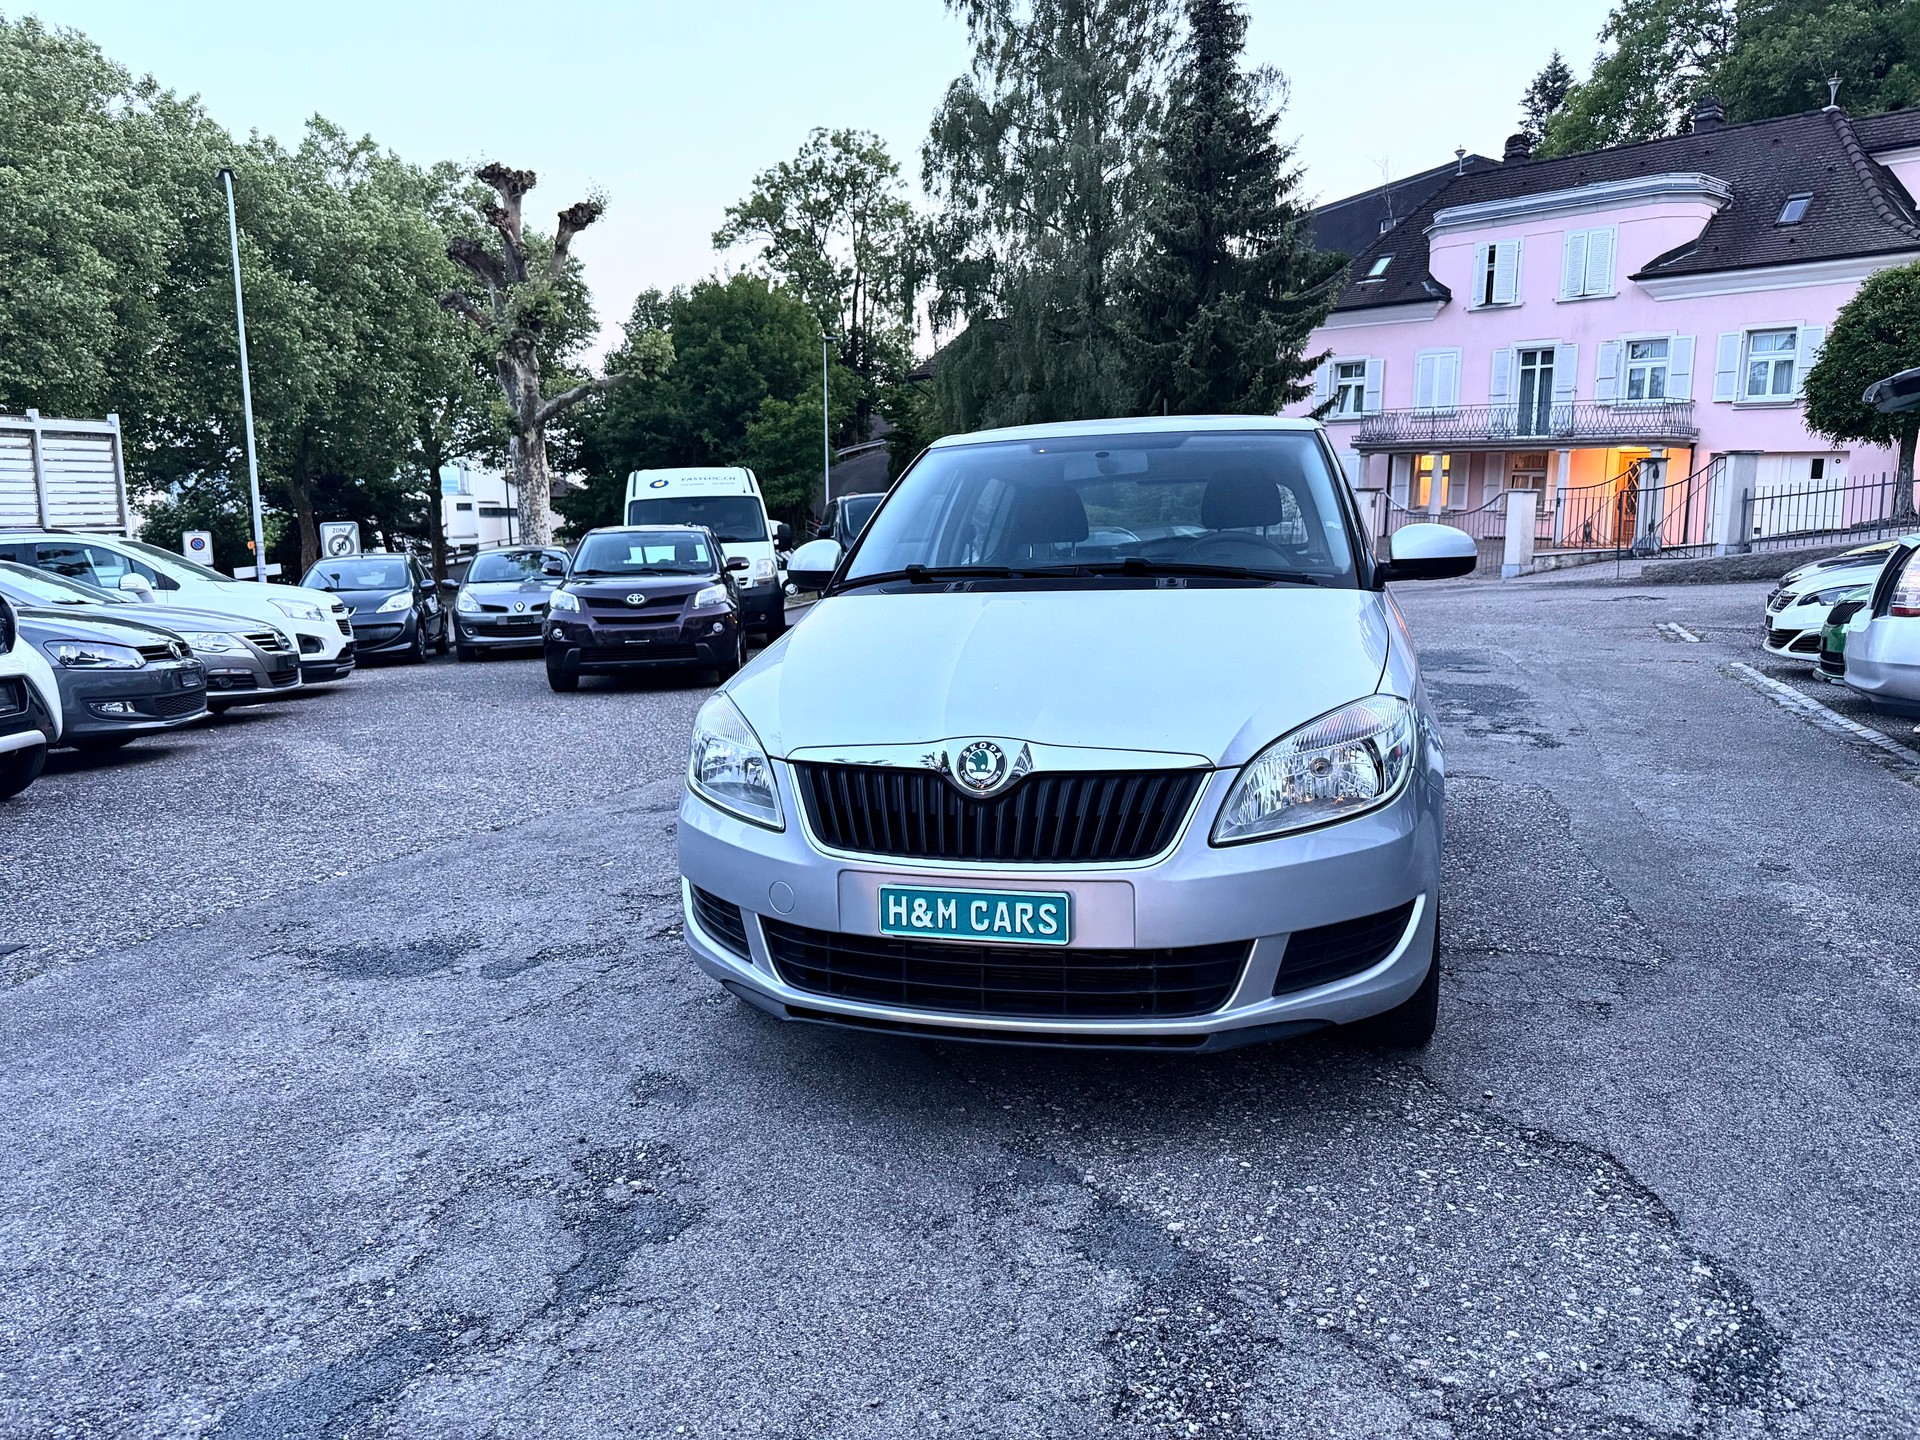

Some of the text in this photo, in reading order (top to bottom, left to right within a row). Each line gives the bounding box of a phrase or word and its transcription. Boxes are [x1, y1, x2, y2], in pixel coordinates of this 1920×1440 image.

[336, 541, 347, 551] 30
[888, 894, 1058, 935] H&M CARS
